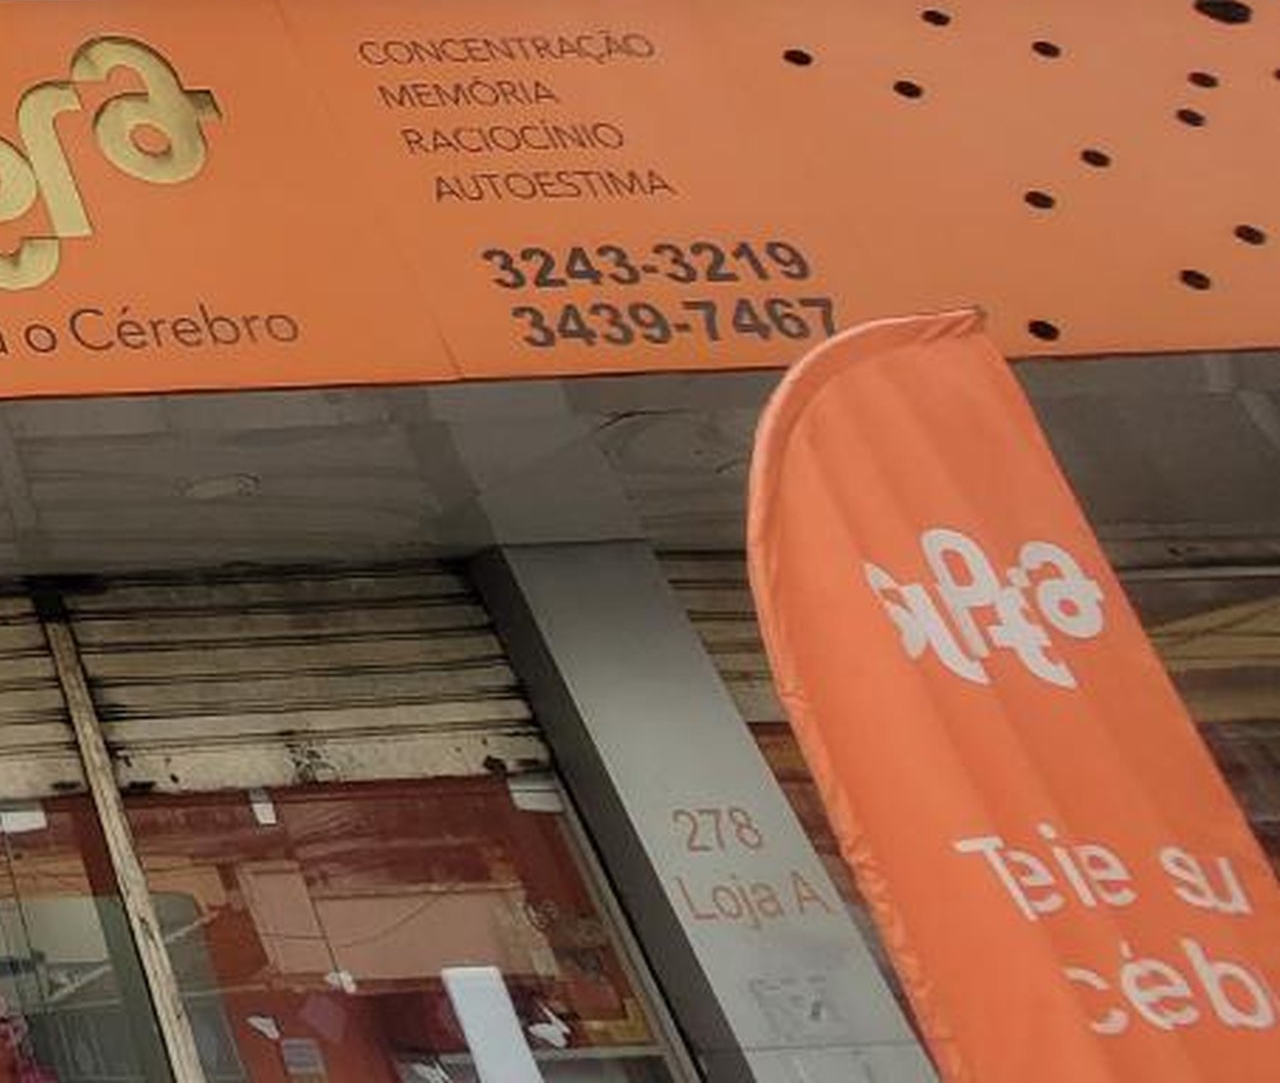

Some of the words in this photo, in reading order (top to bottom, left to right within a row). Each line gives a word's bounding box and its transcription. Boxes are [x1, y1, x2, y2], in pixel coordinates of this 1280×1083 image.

[358, 30, 656, 66] CONCENTRAÇÃO
[378, 76, 561, 110] MEMÓRIA
[400, 120, 625, 154] RACIOCÍNIO
[433, 168, 676, 203] AUTOESTIMA
[482, 241, 810, 289] 3243-3219
[24, 323, 58, 353] o
[68, 303, 300, 351] Cérebro
[511, 297, 836, 348] 3439-7467
[672, 807, 763, 853] 278
[675, 874, 784, 930] Loja
[792, 870, 836, 914] A
